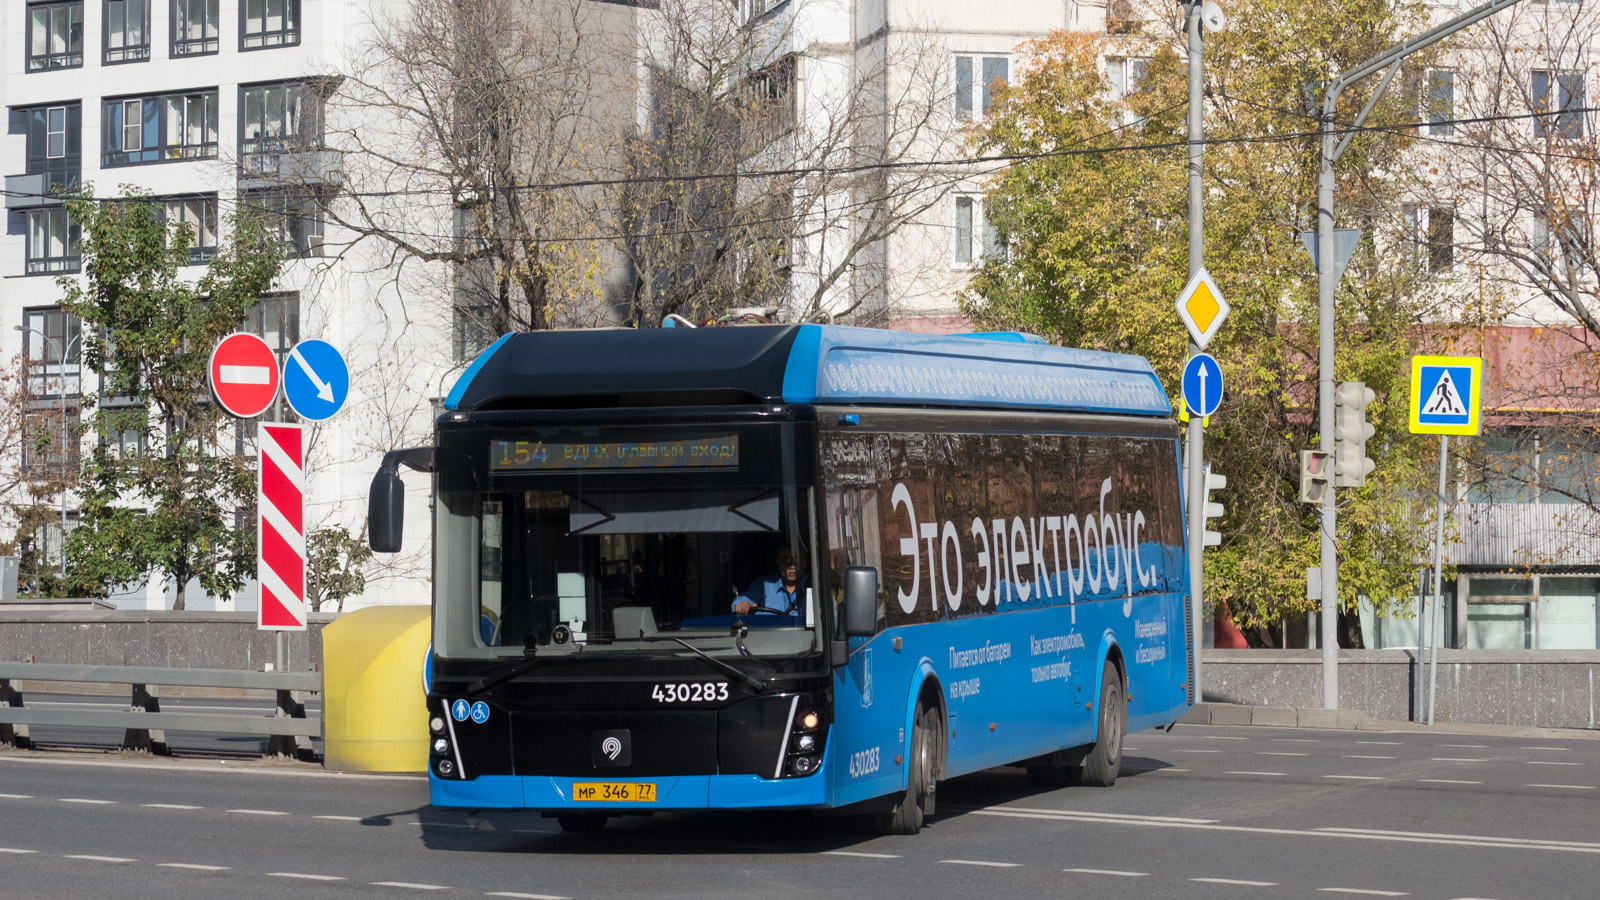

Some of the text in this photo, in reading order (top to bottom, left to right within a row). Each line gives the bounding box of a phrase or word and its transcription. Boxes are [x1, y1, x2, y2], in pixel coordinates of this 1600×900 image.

[499, 440, 549, 465] 154
[617, 442, 684, 460] (главный
[691, 440, 736, 459] вход)
[890, 476, 1157, 624] Это электробус.
[949, 639, 1011, 669] Питается от батареи
[1030, 627, 1085, 656] Как электромобиль,
[1139, 641, 1166, 666] бесшумный
[1031, 656, 1071, 683] только автобус
[651, 682, 729, 703] 430283
[950, 677, 980, 702] на крыше
[849, 746, 880, 778] 430283
[603, 784, 629, 799] 346
[637, 784, 651, 795] 77
